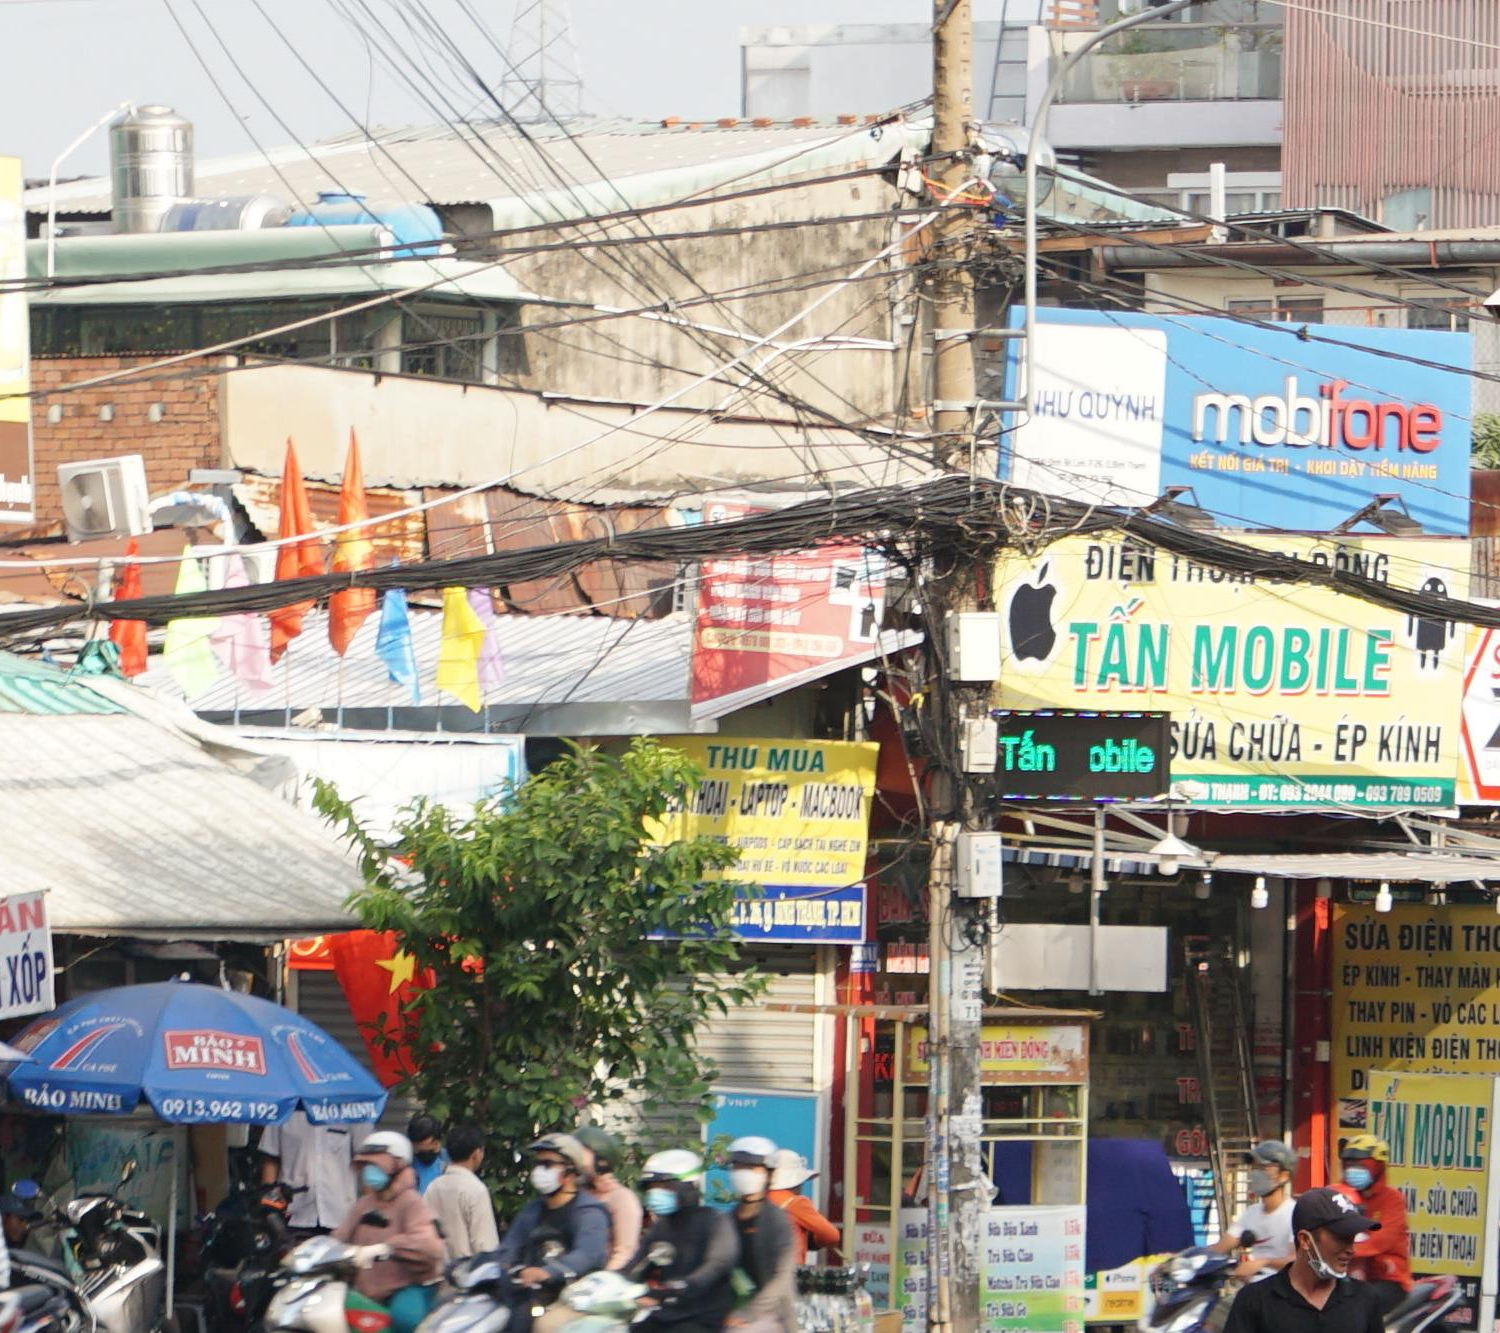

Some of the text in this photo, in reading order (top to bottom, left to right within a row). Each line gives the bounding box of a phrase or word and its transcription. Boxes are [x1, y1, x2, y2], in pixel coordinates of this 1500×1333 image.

[1192, 375, 1443, 454] mobifone
[1070, 598, 1394, 697] TẤN MOBILE
[1001, 730, 1056, 773] Tấn
[1229, 710, 1441, 763] CHỮA ÉP KÍNH
[707, 746, 825, 773] THU MUA
[740, 783, 864, 820] LAPTOP MACBOOK
[1345, 916, 1390, 950] SỬA
[1398, 918, 1452, 957] ĐIỆN
[7, 933, 46, 1007] XỐP
[1343, 960, 1360, 986] ÉP
[1366, 960, 1399, 987] KÍNH
[1416, 966, 1453, 988] THAY
[1458, 962, 1490, 988] MÀN
[1348, 1001, 1385, 1022] THAY
[1391, 1002, 1414, 1023] PIN
[1457, 998, 1487, 1024] CÁC
[174, 1046, 258, 1070] MINH
[1347, 1036, 1383, 1057] LINH
[1390, 1032, 1426, 1064] KIỆN
[1431, 1033, 1470, 1064] ĐIỆN
[23, 1084, 122, 1111] BẢO MINH
[162, 1099, 278, 1120] 0913.962 192
[1412, 1103, 1488, 1171] MOBILE
[1420, 1227, 1476, 1267] ĐIỆN THOẠI
